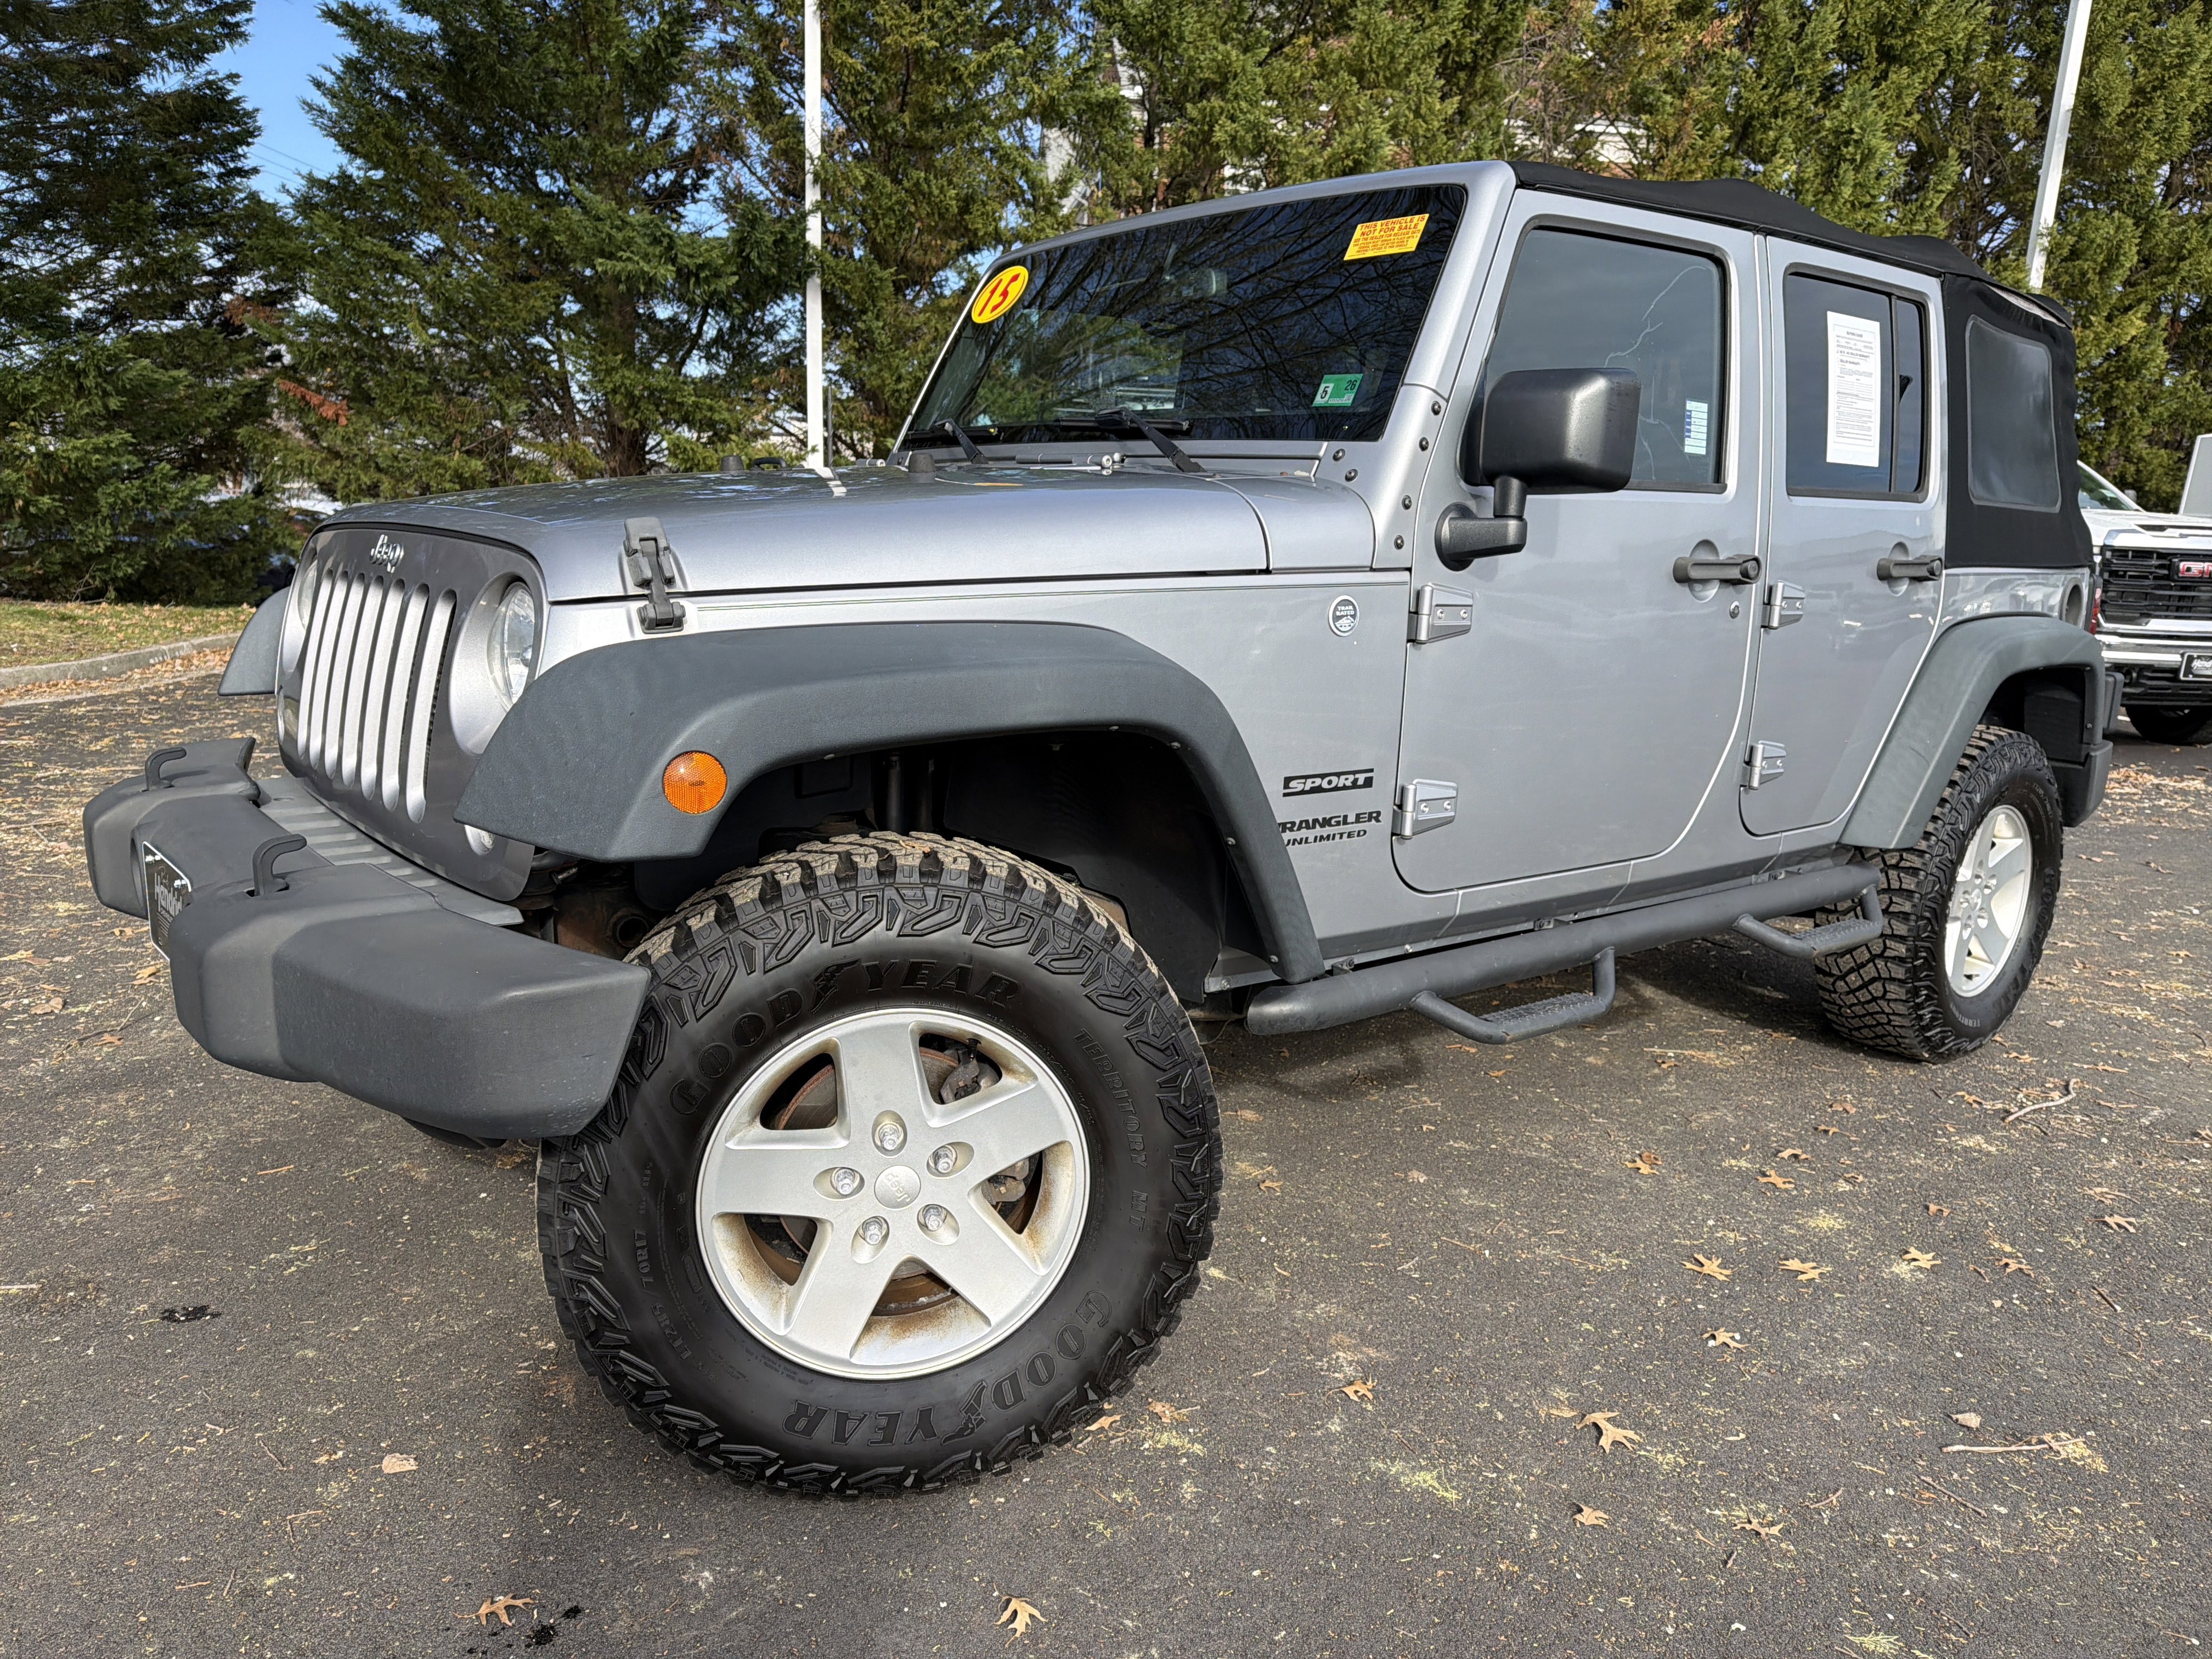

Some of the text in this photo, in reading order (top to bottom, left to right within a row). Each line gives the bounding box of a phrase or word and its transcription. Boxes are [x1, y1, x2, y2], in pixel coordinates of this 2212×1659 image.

[1360, 229, 1378, 237] NOT
[1397, 223, 1419, 231] SALE
[1361, 222, 1378, 230] THIS
[1380, 217, 1415, 227] VEHICLE
[978, 272, 1022, 317] 15
[1320, 386, 1330, 399] 5
[1345, 379, 1358, 391] 26
[369, 534, 404, 573] Jeep
[1284, 772, 1374, 793] SPORT
[1278, 810, 1383, 833] RANGLER
[1073, 1028, 1148, 1233] TERRITORY MT
[884, 1173, 911, 1203] Jeep
